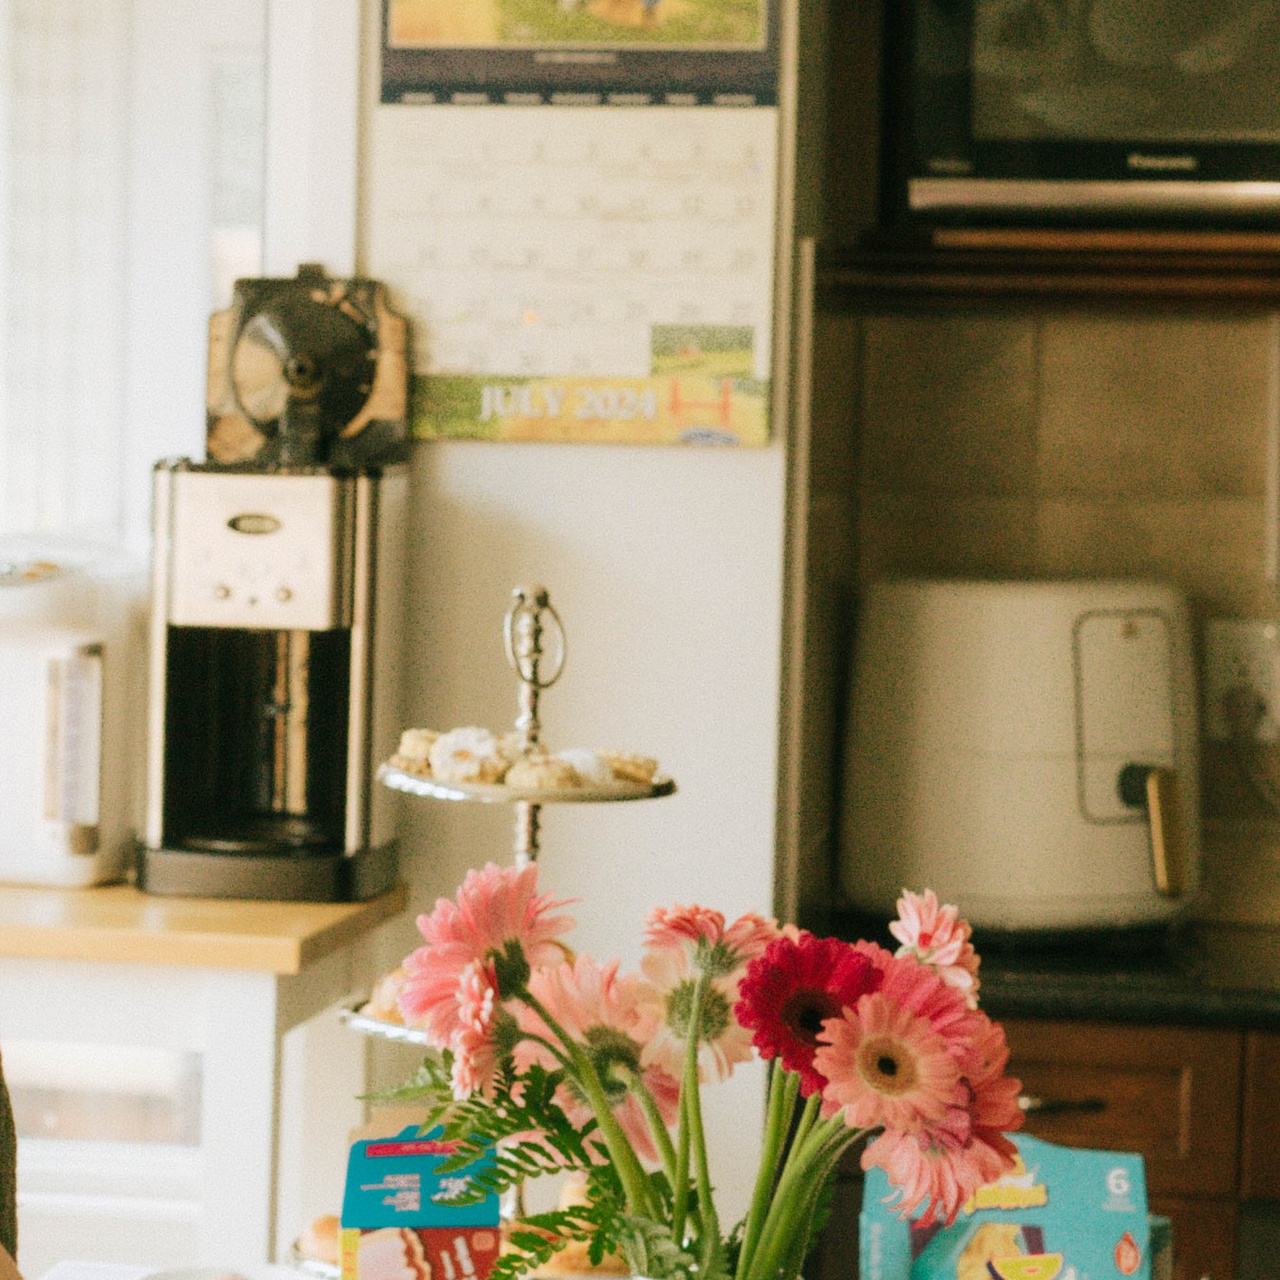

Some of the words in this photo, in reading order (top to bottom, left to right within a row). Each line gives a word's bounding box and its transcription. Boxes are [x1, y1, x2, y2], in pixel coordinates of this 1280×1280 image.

[478, 385, 567, 423] JULY
[572, 384, 657, 421] 2024
[1105, 1167, 1132, 1196] 6
